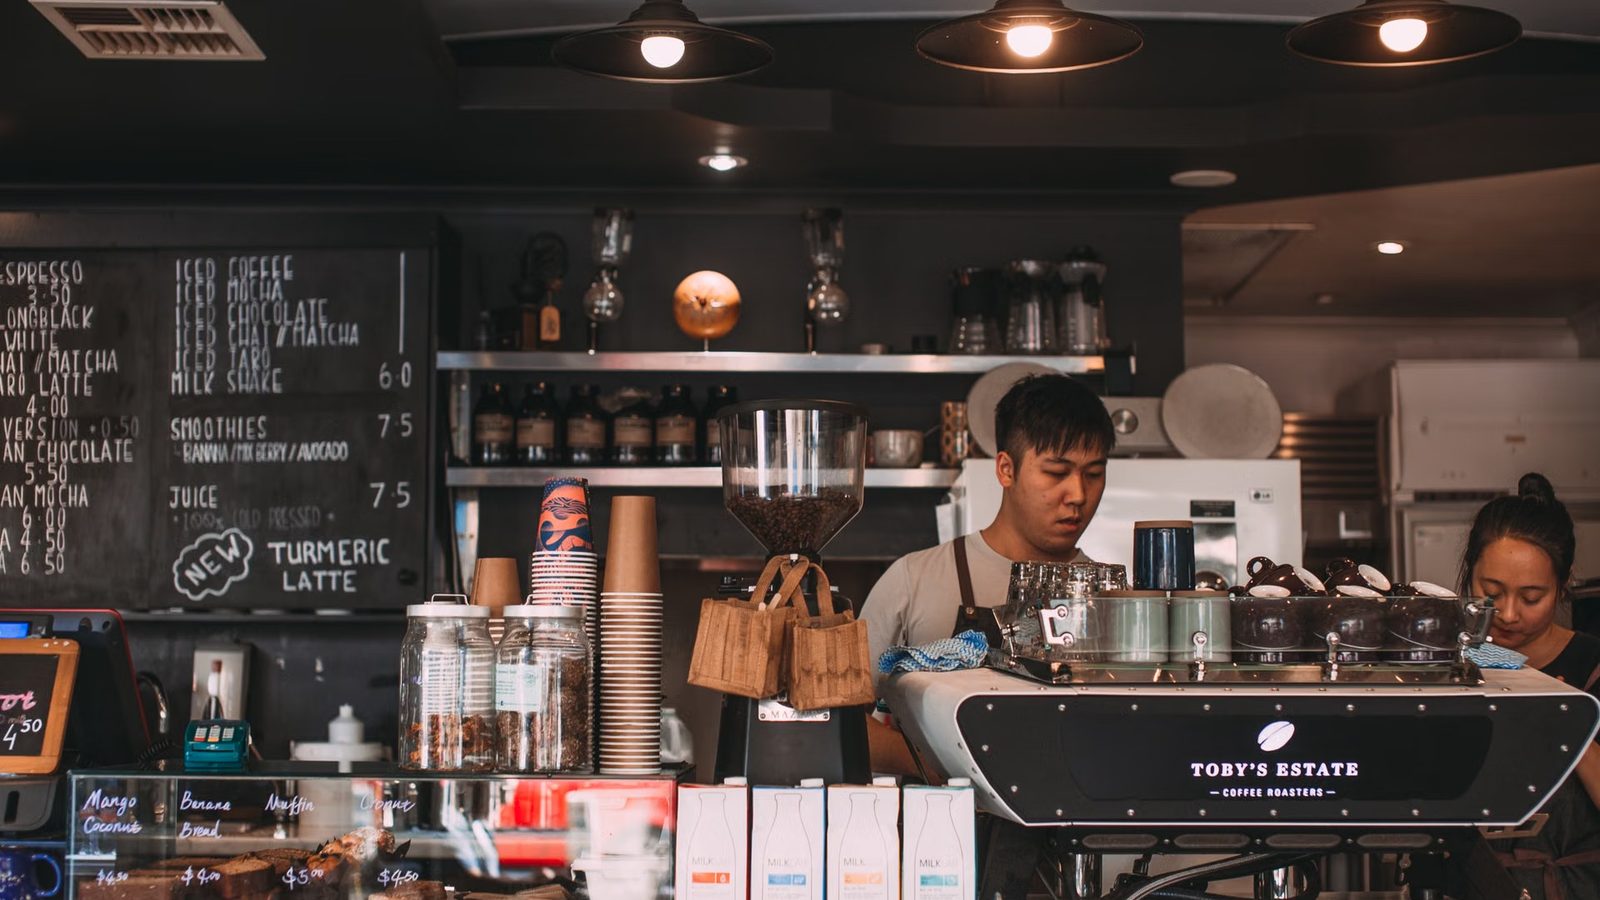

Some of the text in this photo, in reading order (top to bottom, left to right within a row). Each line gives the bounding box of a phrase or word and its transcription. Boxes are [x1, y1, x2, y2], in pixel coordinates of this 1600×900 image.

[175, 255, 294, 282] ICED COFFEE
[175, 278, 283, 305] ICED MOCHA
[175, 298, 328, 328] ICED CHOCOLATE
[4, 329, 59, 351] WHITE
[175, 326, 217, 351] ICED
[175, 348, 271, 372] ICED TARO
[39, 372, 93, 397] LATTE
[171, 367, 282, 395] MILK SHAKE
[3, 416, 79, 441] VERSION
[170, 415, 267, 441] SMOOTHIES
[3, 438, 134, 464] AN CHOCOLATE
[1, 484, 89, 508] AN MOCHA
[169, 485, 218, 509] JUICE
[184, 533, 241, 586] NEW
[267, 538, 390, 565] TURMERIC
[283, 570, 357, 592] LATTE
[1191, 762, 1359, 777] TOBY'S ESTATE
[83, 788, 137, 816] Mango
[179, 790, 232, 811] Banana
[264, 792, 316, 816] Muffin
[1222, 788, 1323, 797] COFFEE ROASTERS
[83, 816, 143, 834] Coconut
[179, 819, 222, 839] Bread
